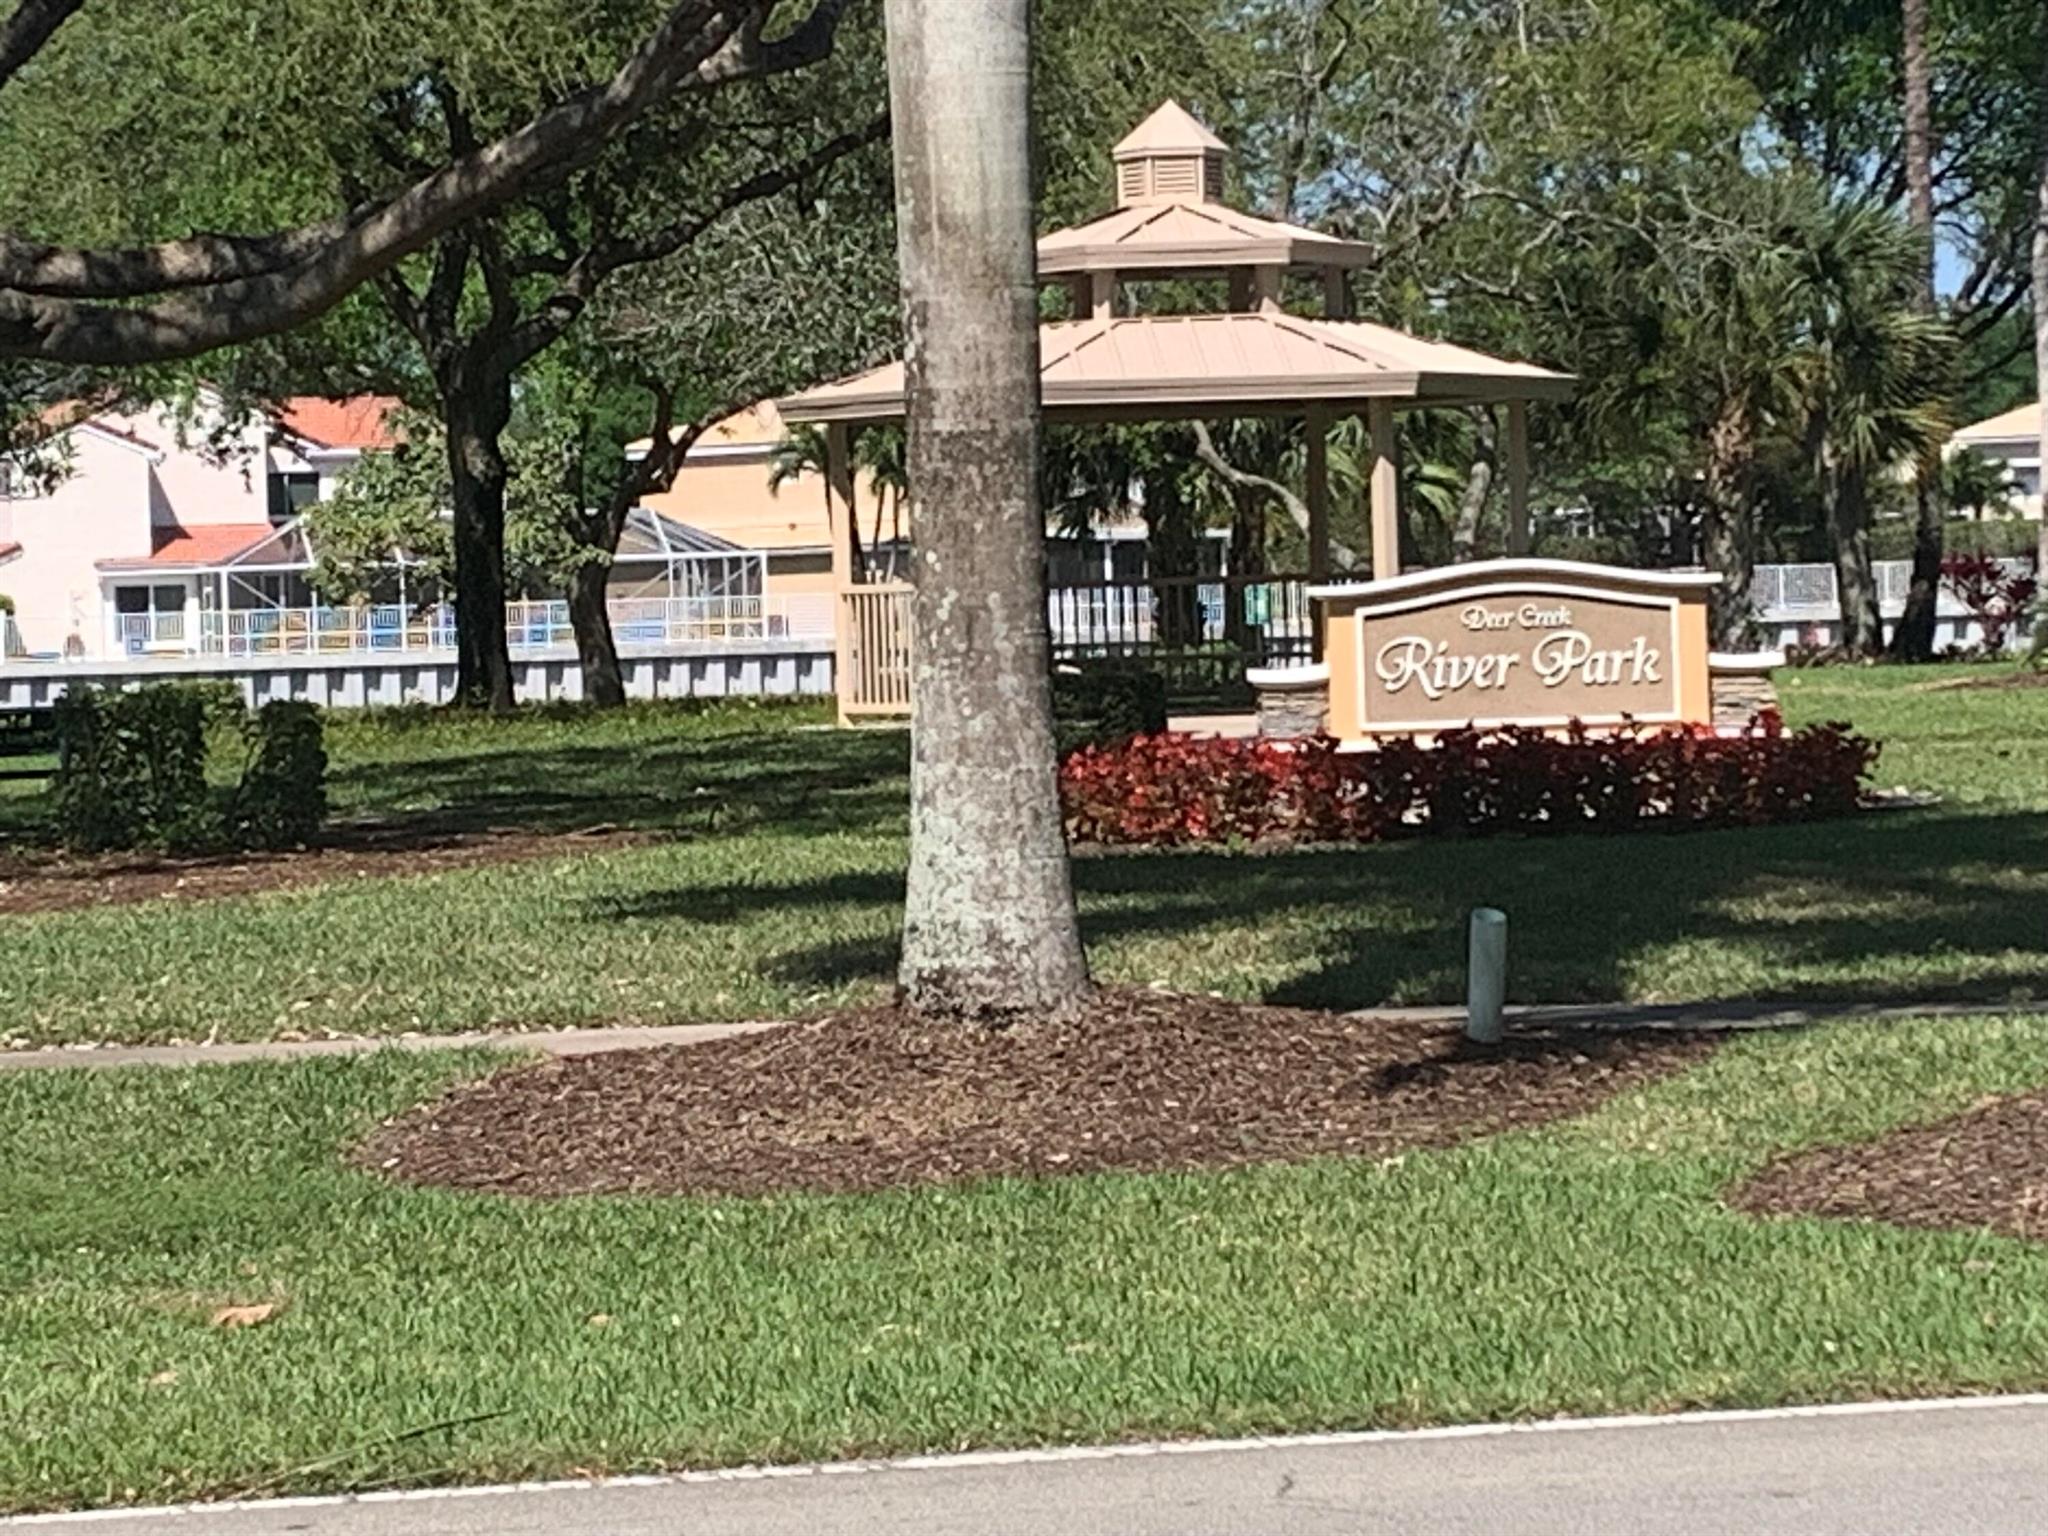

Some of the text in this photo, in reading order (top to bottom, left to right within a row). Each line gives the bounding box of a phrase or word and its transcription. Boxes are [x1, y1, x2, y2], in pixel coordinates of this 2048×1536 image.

[1460, 603, 1573, 630] Deer Creek
[1375, 630, 1662, 699] River Park
